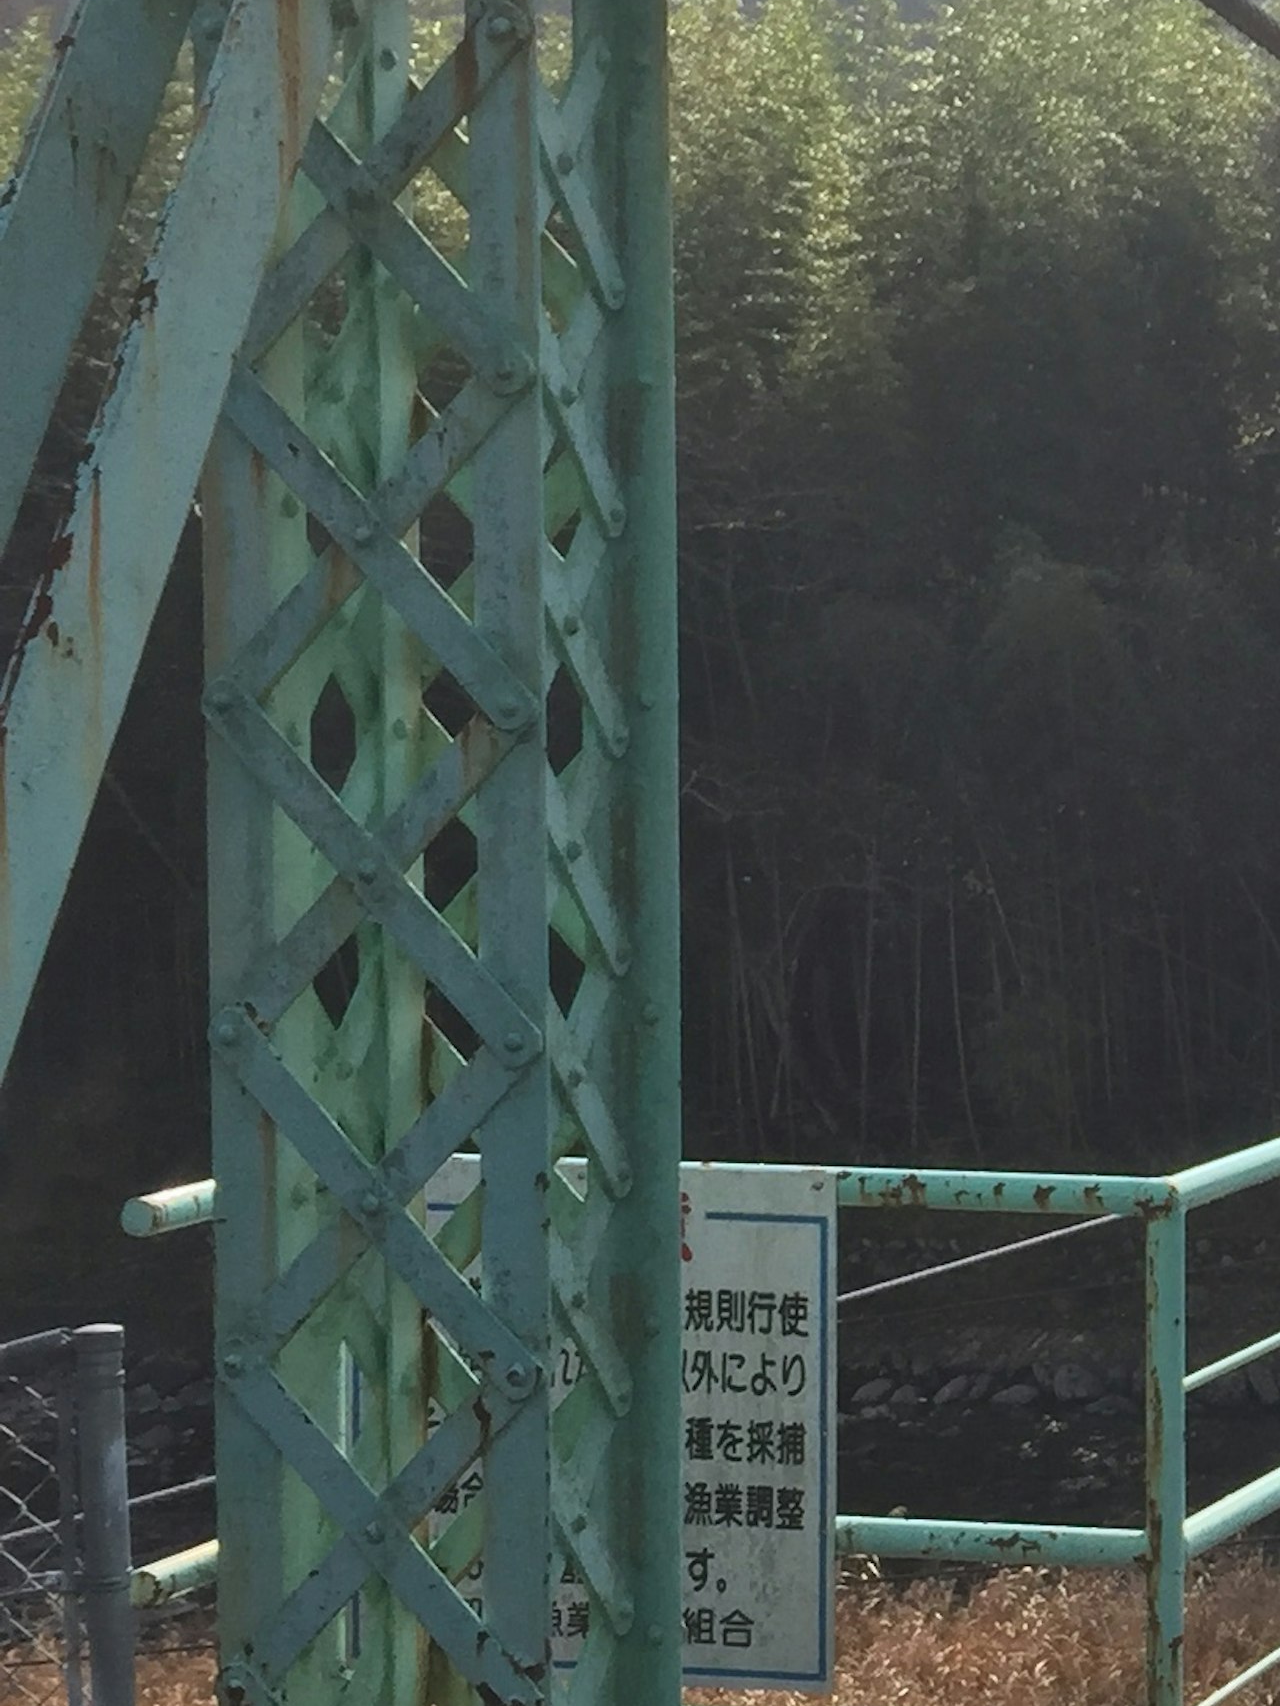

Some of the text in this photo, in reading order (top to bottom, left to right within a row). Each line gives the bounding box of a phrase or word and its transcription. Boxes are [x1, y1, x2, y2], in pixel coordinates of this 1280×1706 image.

[684, 1288, 809, 1338] 規則行使
[685, 1417, 806, 1467] 種を採捕
[684, 1482, 806, 1532] 漁業調整
[684, 1608, 755, 1648] 組合
